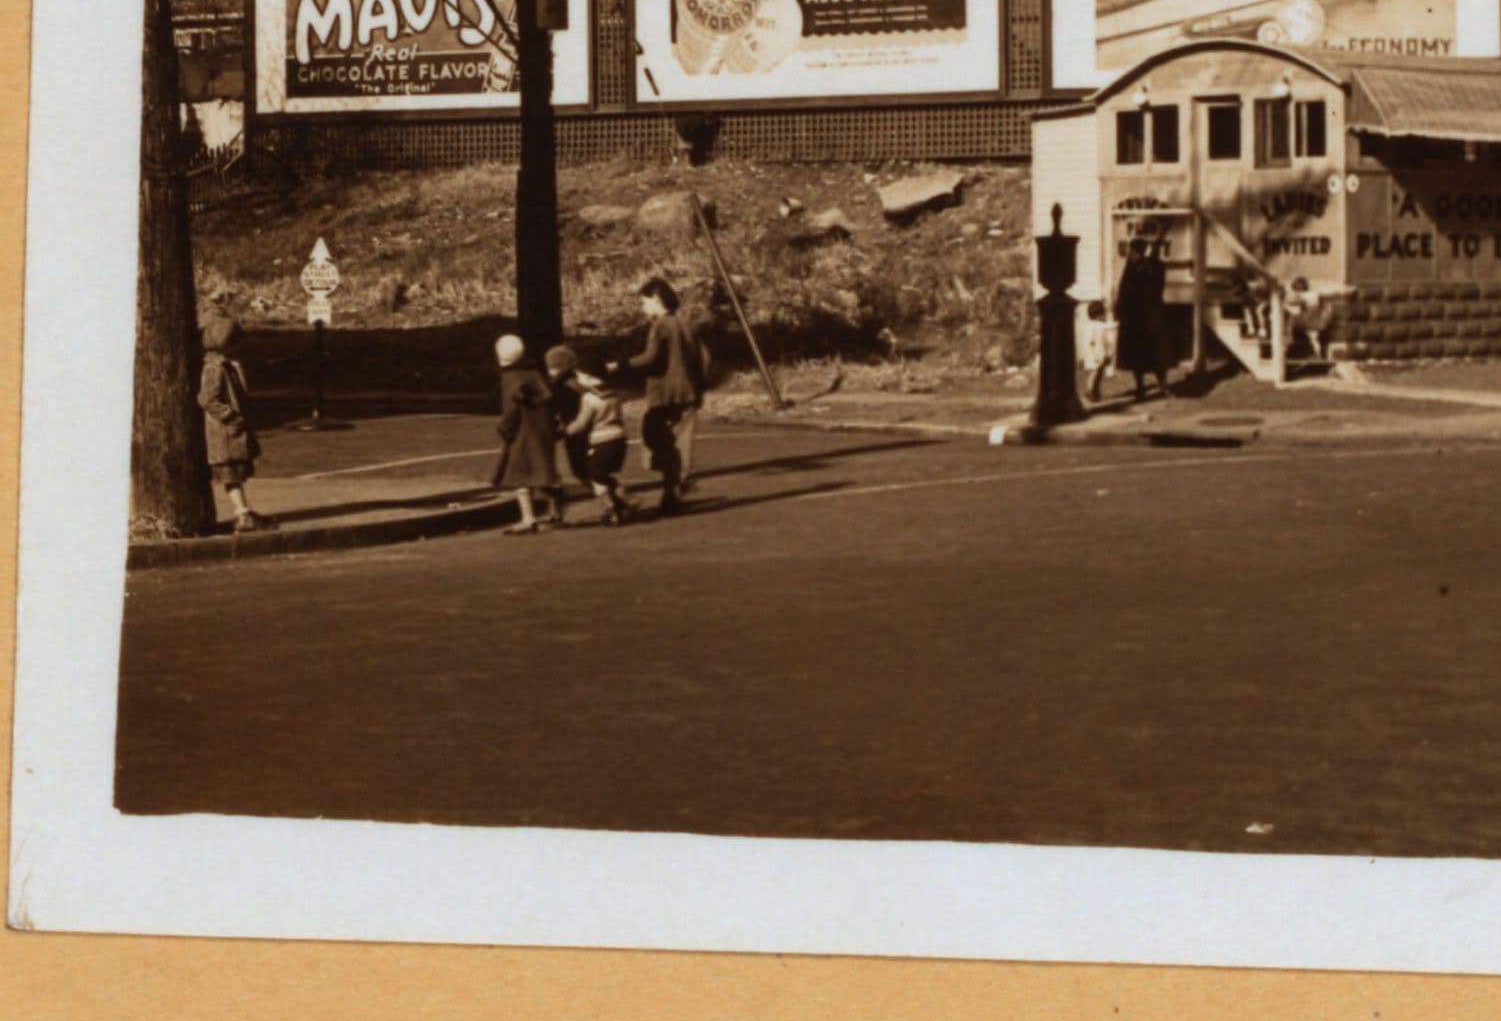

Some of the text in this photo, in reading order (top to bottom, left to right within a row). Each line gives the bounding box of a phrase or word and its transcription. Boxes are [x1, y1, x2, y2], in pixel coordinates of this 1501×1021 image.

[364, 43, 419, 63] Real
[1348, 37, 1454, 55] ECONOMY
[298, 60, 489, 83] CHOCOLATE FLAVOR
[1263, 235, 1332, 255] INVITED
[1356, 232, 1435, 259] PLACE
[1449, 232, 1482, 259] TO
